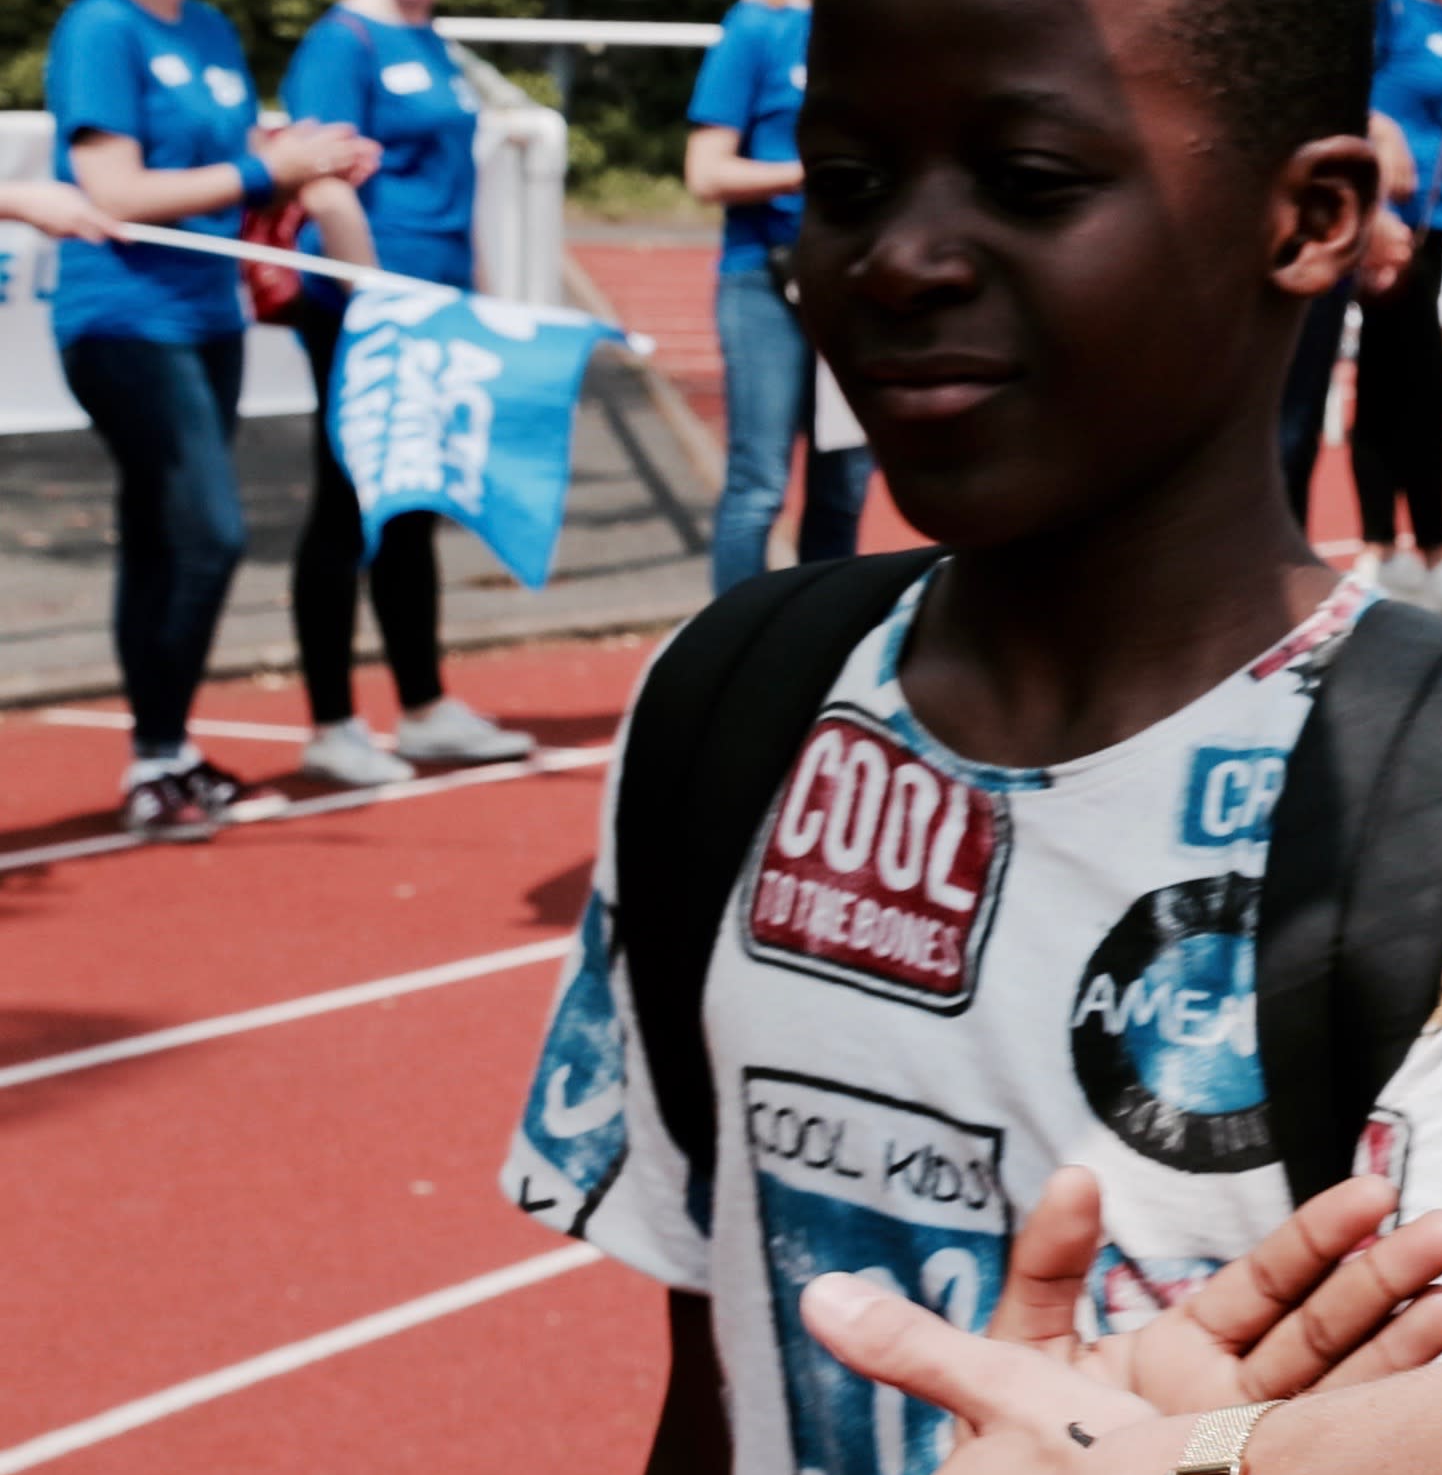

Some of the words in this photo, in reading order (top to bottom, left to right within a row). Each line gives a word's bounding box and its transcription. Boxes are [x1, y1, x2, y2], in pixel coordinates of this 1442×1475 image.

[776, 728, 977, 912] COOL
[754, 870, 797, 926] TO
[791, 880, 859, 944] THE
[849, 897, 962, 977] BONES
[748, 1102, 863, 1179] COOL
[884, 1139, 993, 1211] KIDS
